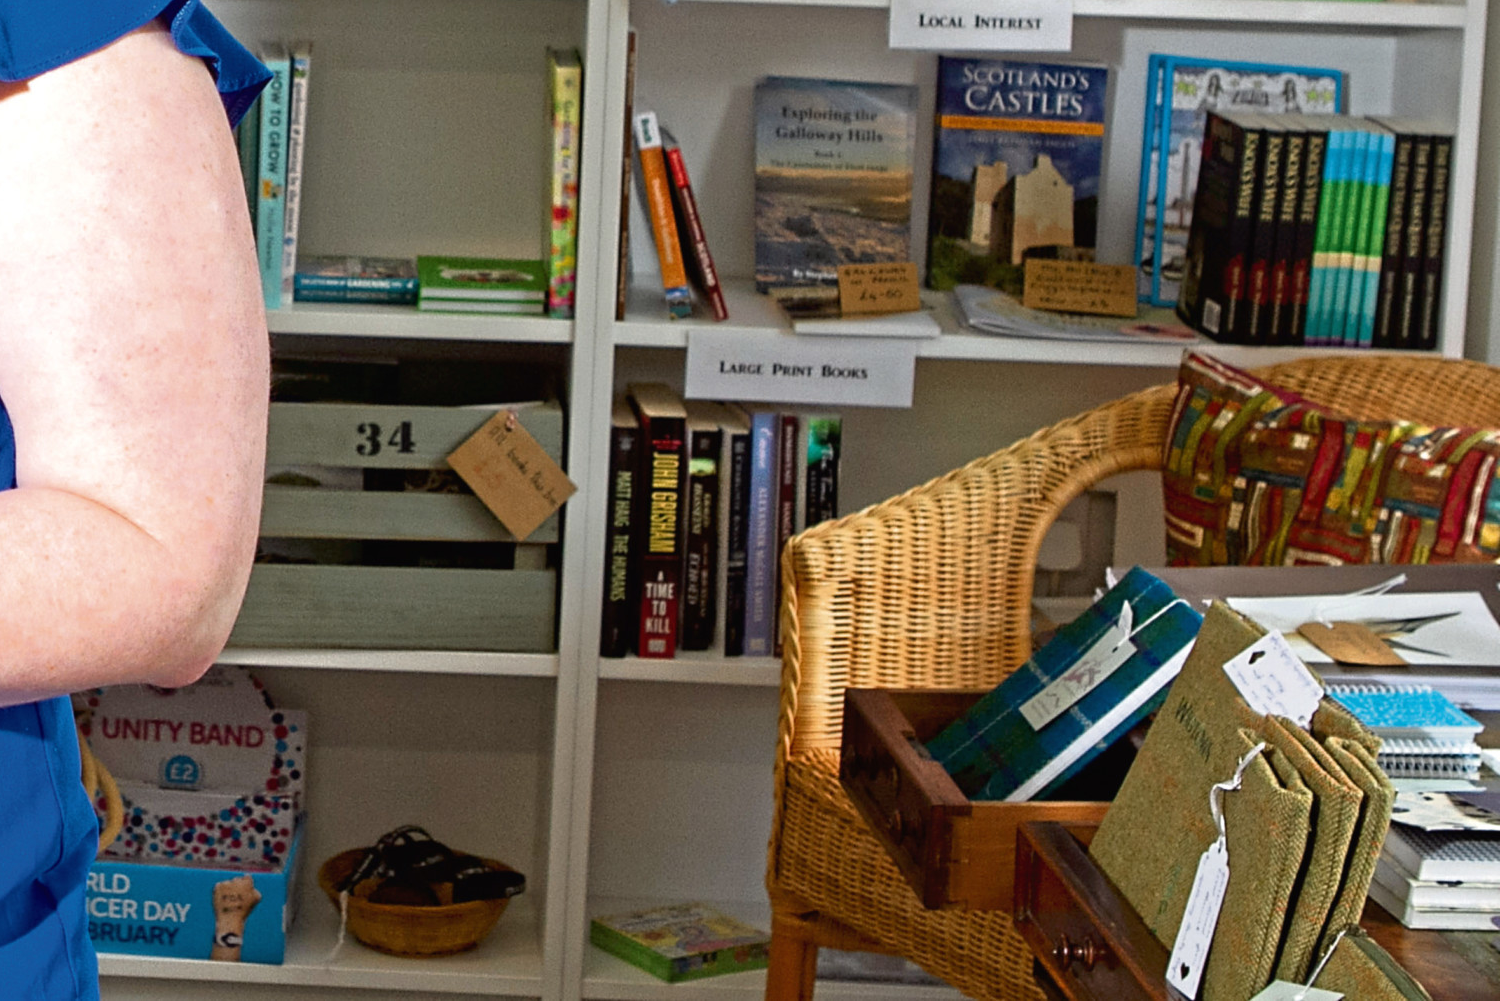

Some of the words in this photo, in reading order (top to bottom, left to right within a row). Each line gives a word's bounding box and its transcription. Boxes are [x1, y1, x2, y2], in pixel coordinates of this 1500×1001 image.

[919, 14, 965, 29] LOCAL
[974, 14, 1043, 31] INTEREST
[271, 70, 282, 105] HOW
[963, 64, 1090, 91] SCOTLAND'S
[781, 106, 851, 124] Exploring
[855, 108, 878, 121] the
[965, 85, 1083, 116] CASTLES
[776, 127, 843, 144] Galloway
[848, 130, 884, 143] Hills
[268, 131, 280, 174] GROW
[1241, 132, 1260, 182] KNOX'S
[1262, 136, 1283, 187] KNOX'S
[1284, 136, 1303, 186] KNOX'S
[1305, 135, 1324, 186] KNOX'S
[1236, 184, 1255, 218] WIFE
[1260, 189, 1277, 222] WIFE
[1280, 188, 1297, 223] WIFE
[1301, 189, 1317, 223] WIFE
[719, 361, 763, 375] LARGE
[772, 363, 814, 378] PRINT
[822, 365, 868, 379] BOOKS
[355, 421, 416, 456] 34
[617, 471, 632, 497] MATT
[651, 452, 680, 488] JOHN
[614, 500, 631, 527] HAIG
[649, 491, 678, 553] GRISHAM
[614, 534, 630, 553] THE
[610, 555, 628, 601] HUMANS
[645, 582, 675, 599] TIME
[688, 553, 701, 605] ECHOED
[653, 600, 667, 616] TO
[645, 617, 672, 634] KILL
[102, 717, 183, 742] UNITY
[189, 723, 265, 747] BAND
[170, 763, 195, 780] £2
[144, 901, 191, 922] DAY
